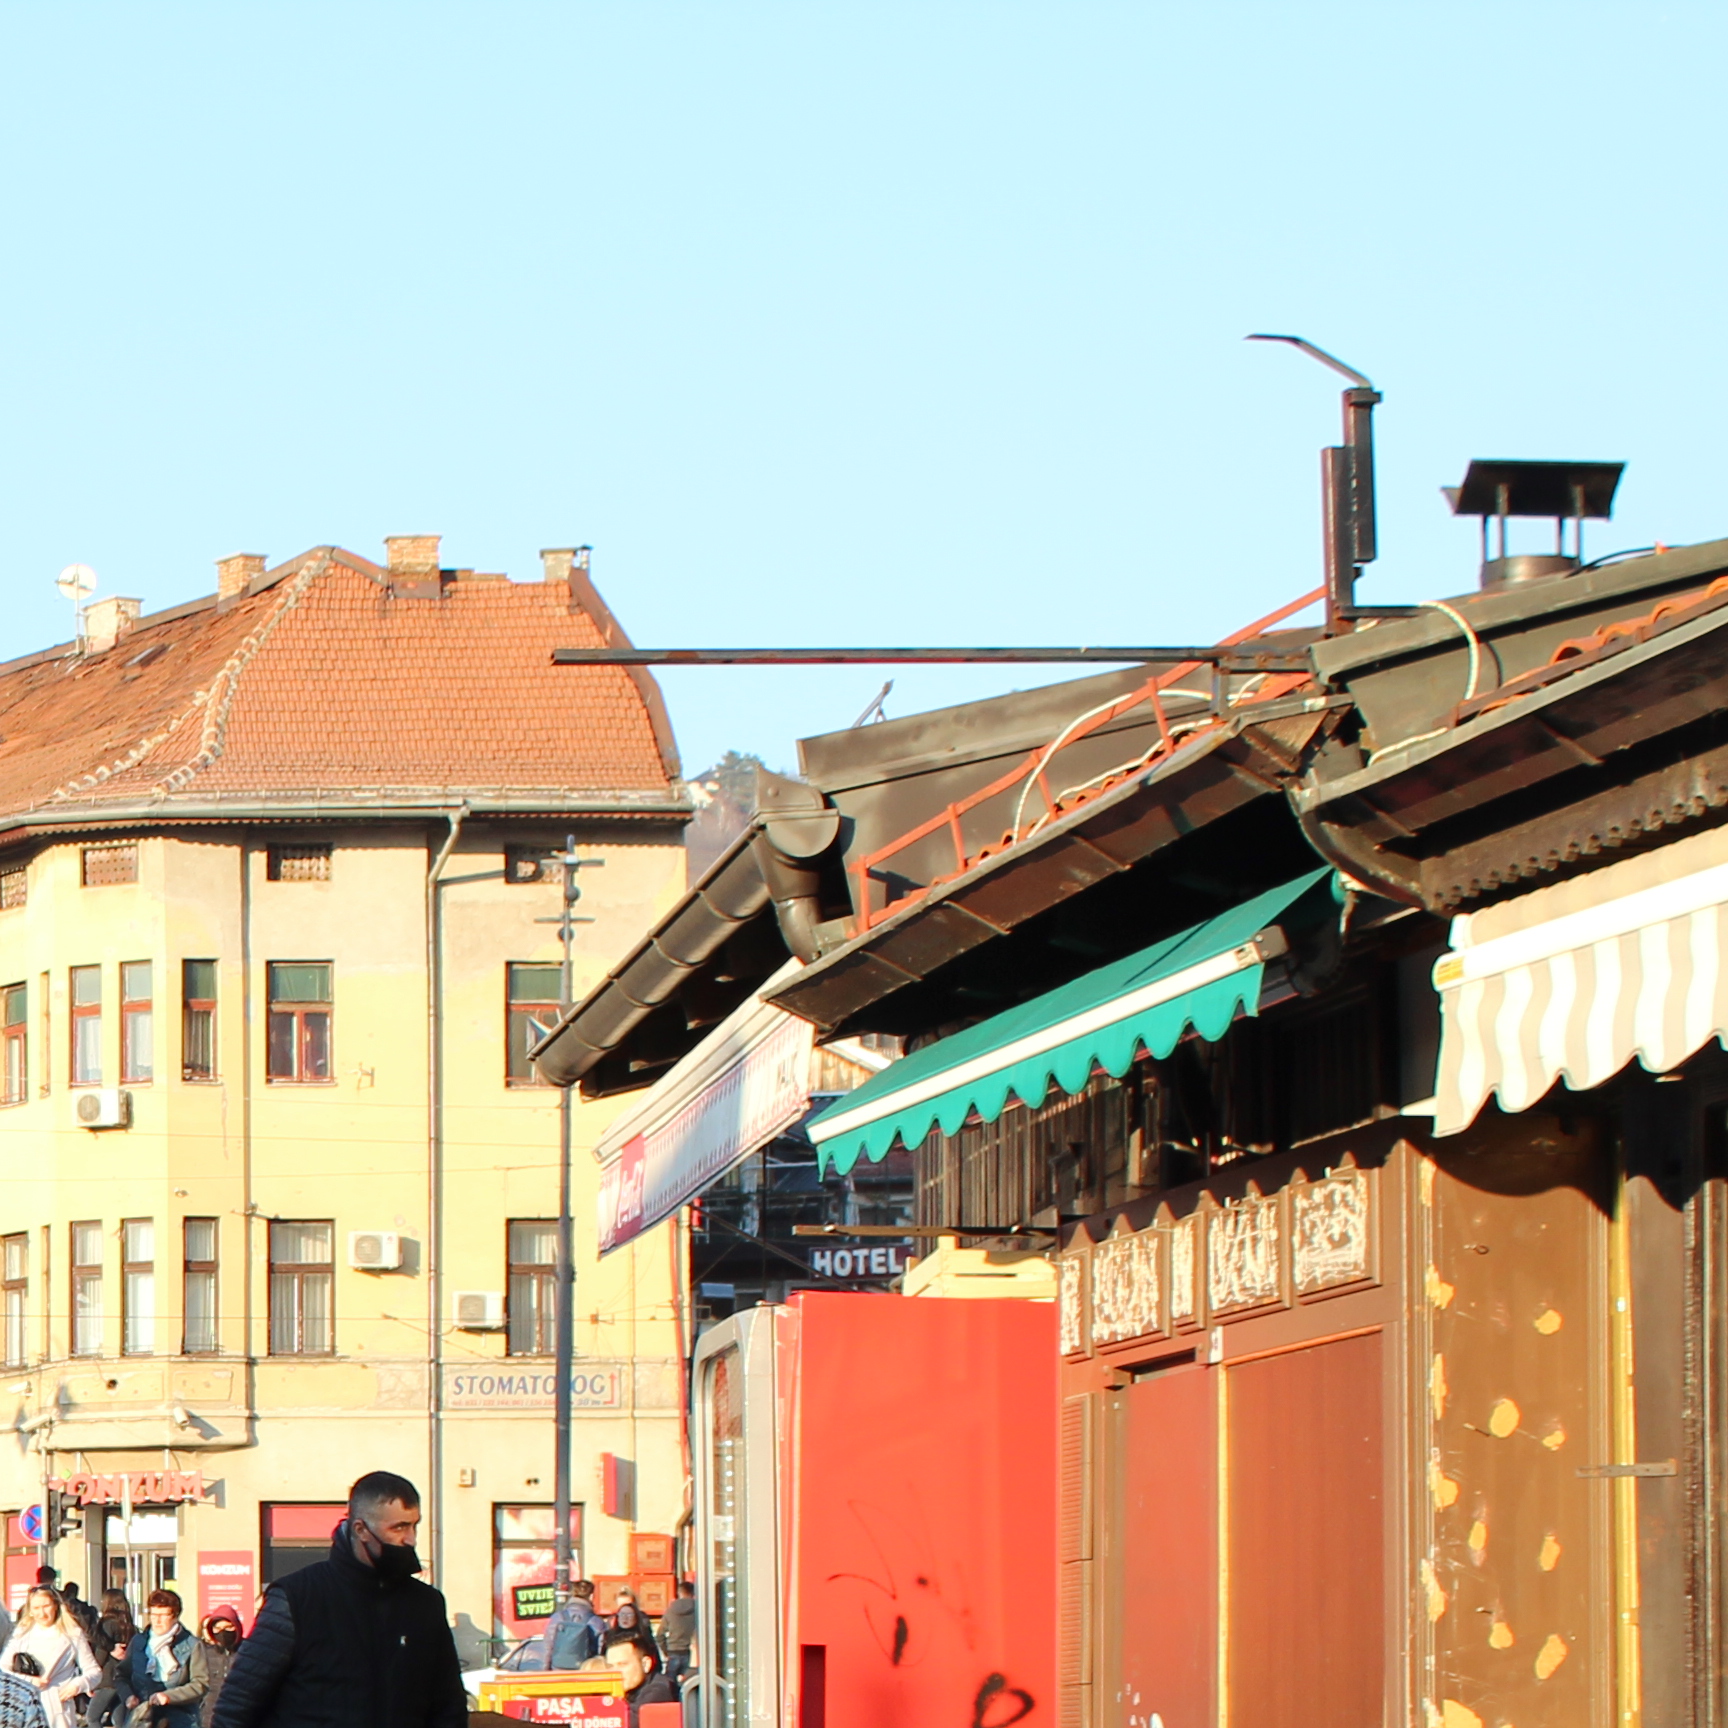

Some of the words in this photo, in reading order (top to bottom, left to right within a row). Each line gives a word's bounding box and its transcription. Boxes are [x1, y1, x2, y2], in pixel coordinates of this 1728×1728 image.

[813, 1247, 904, 1277] HOTEL
[453, 1374, 606, 1396] STOMATOOG
[200, 1564, 250, 1576] KONZUM
